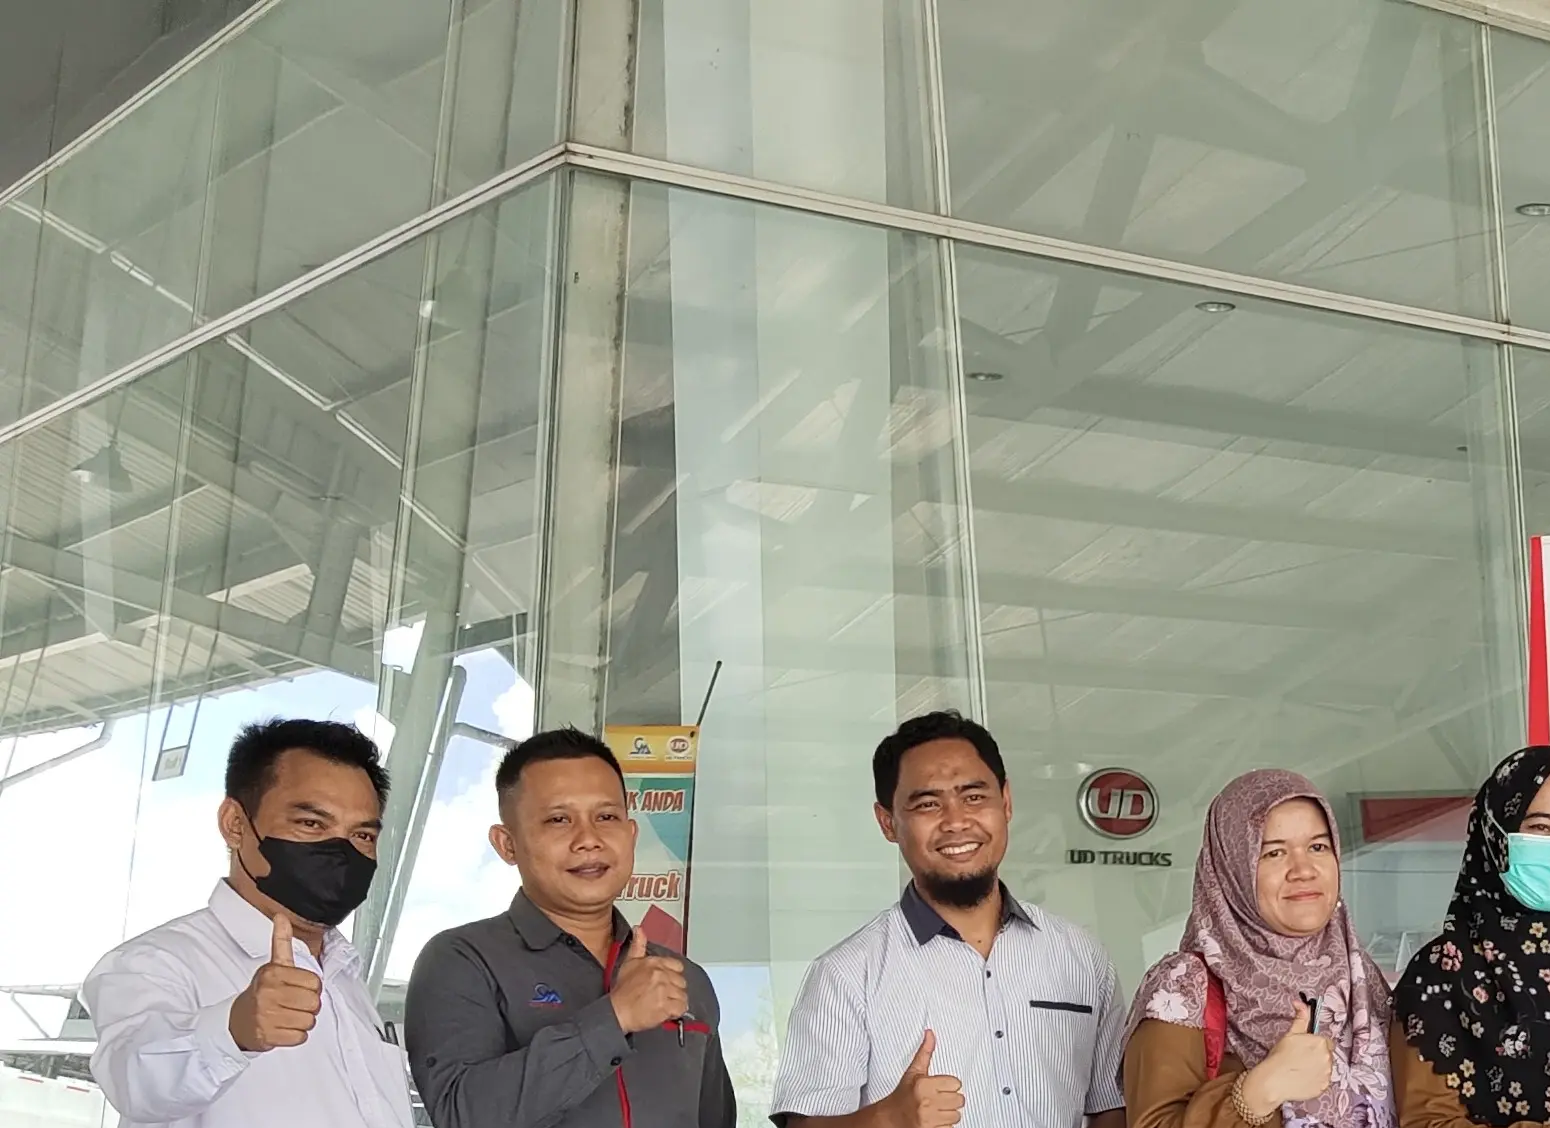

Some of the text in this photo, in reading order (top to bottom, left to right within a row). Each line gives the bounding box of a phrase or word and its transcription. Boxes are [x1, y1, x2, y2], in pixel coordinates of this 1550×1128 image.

[640, 789, 684, 813] ANDA
[1087, 787, 1155, 820] UD
[1069, 849, 1172, 867] UD TRUCKS
[619, 871, 681, 900] ruck
